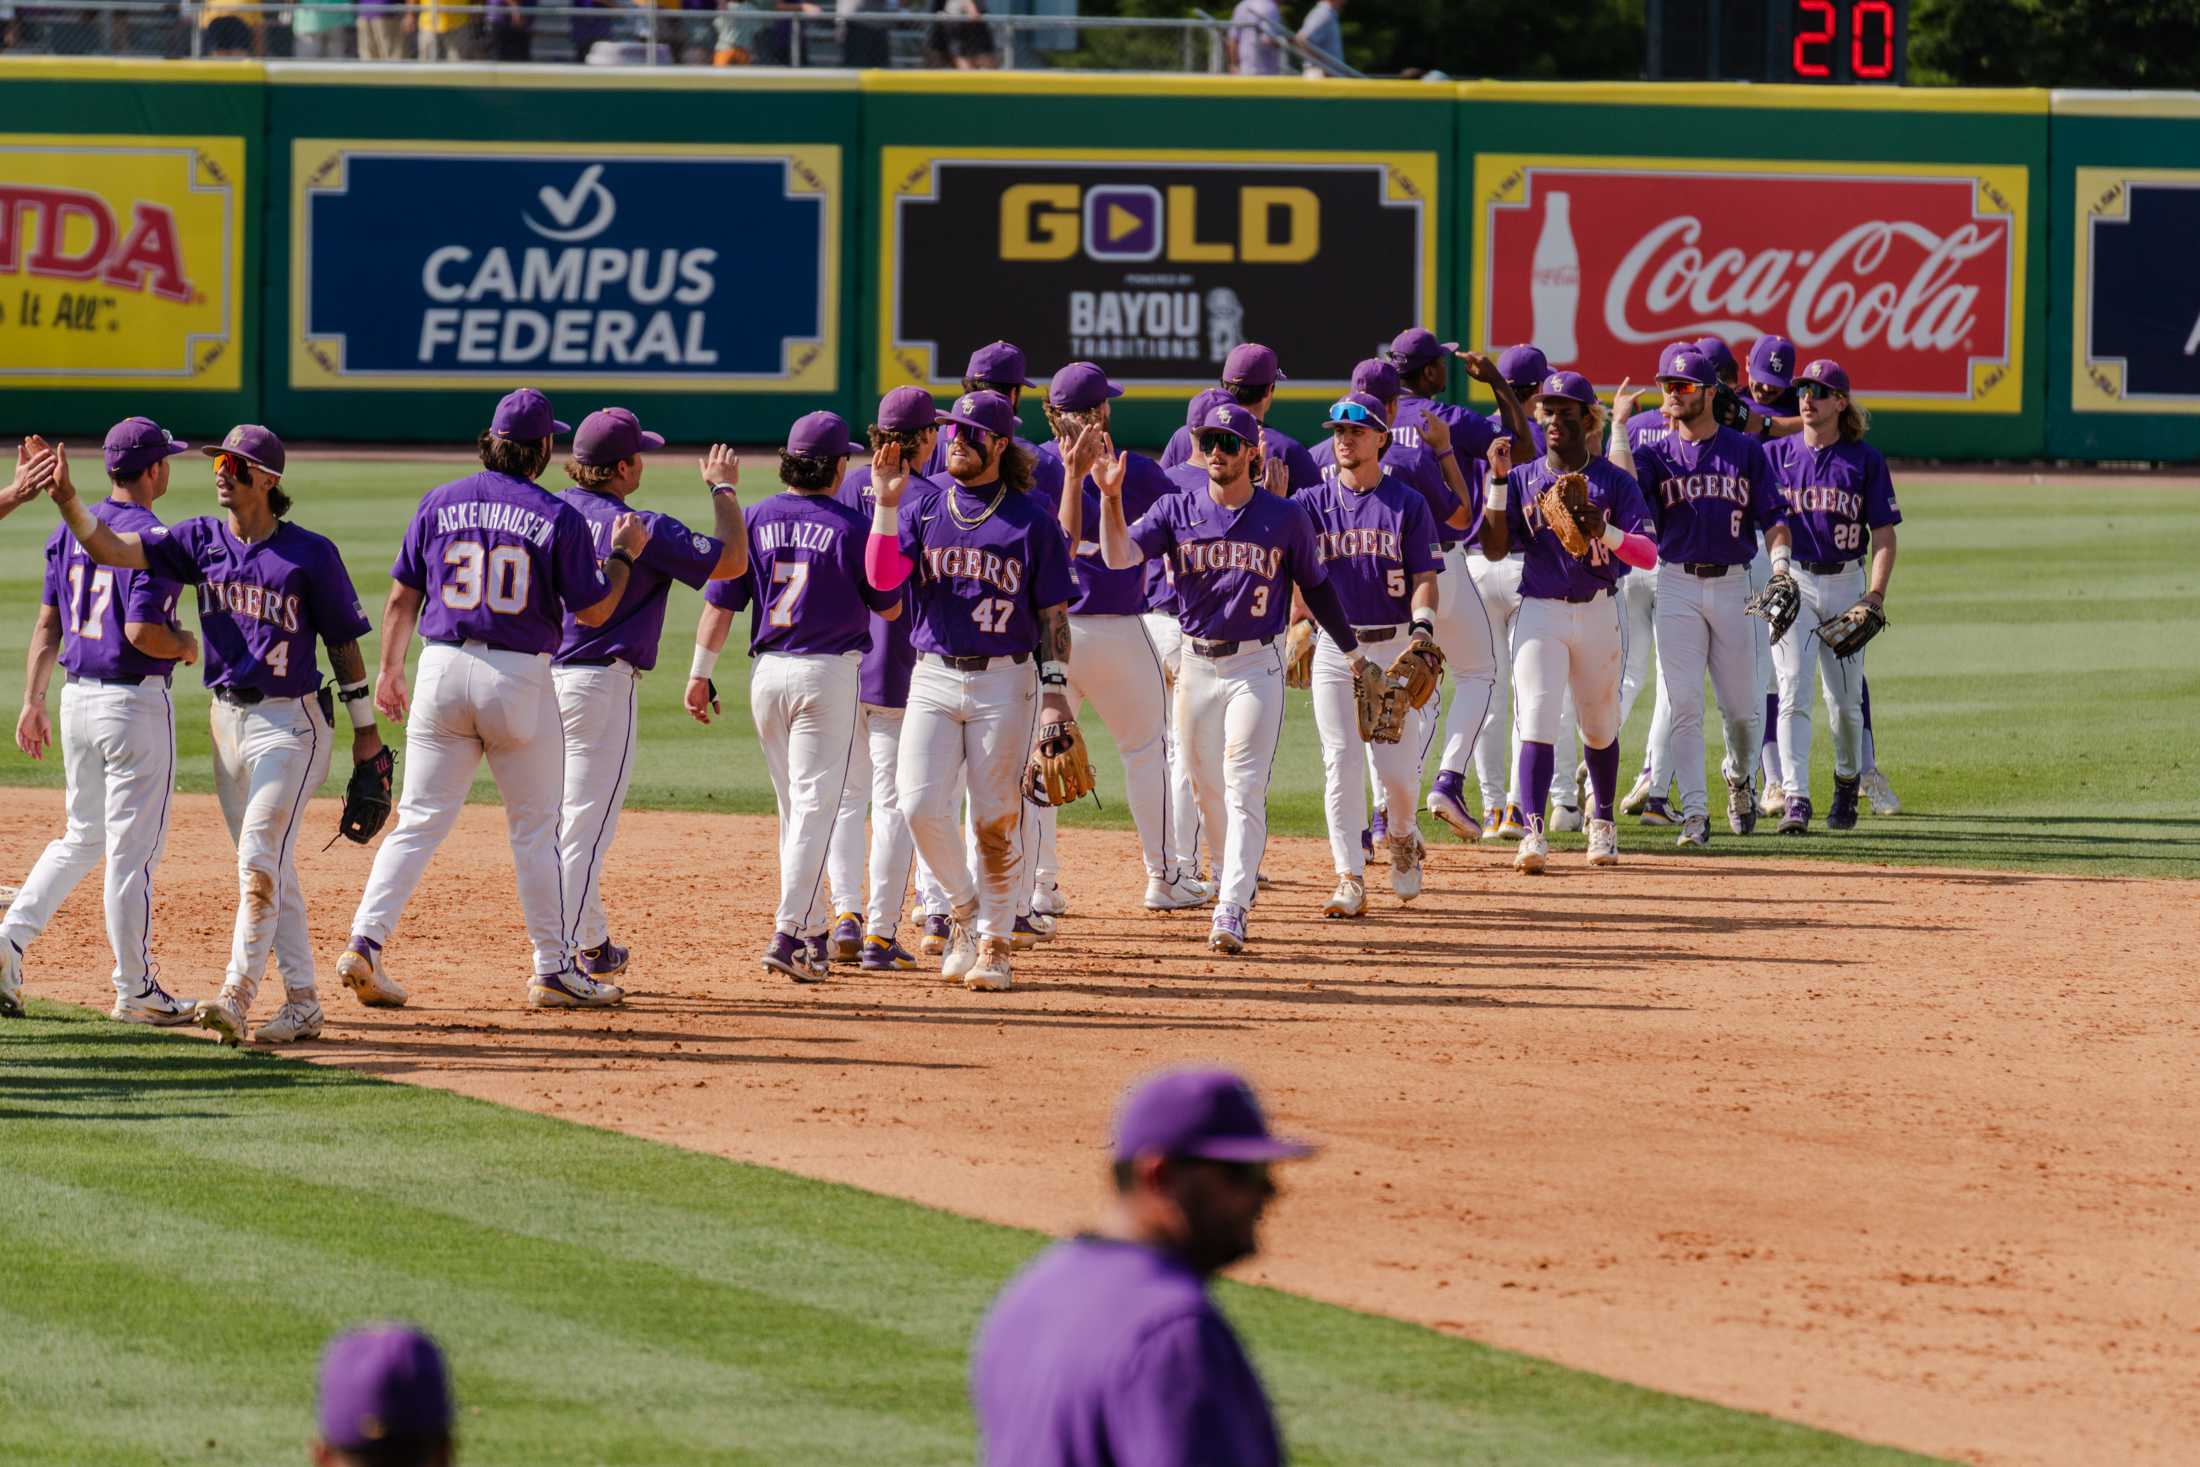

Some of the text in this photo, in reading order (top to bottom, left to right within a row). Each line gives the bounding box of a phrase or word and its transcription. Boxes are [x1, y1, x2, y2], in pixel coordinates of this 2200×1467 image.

[1793, 0, 1893, 78] 20
[999, 184, 1321, 263] GOLD
[422, 245, 718, 303] CAMPUS
[1604, 215, 2004, 351] Coca-Cola
[417, 308, 718, 364] FEDERAL
[1069, 291, 1200, 337] BAYOU
[1071, 339, 1200, 358] TRADITIONS
[1660, 474, 1749, 507] TIGERS
[437, 501, 553, 547] ACKENHAUSEN
[759, 521, 834, 553] MILAZZO
[1730, 509, 1743, 538] 6
[1834, 523, 1860, 550] 28
[442, 541, 531, 615] 30
[1177, 540, 1284, 580] TIGERS
[68, 563, 113, 640] 17
[769, 561, 808, 627] 7
[1251, 585, 1269, 617] 3
[1386, 569, 1406, 598] 5
[198, 580, 299, 634] TIGERS
[971, 598, 1015, 633] 47
[266, 640, 289, 677] 4
